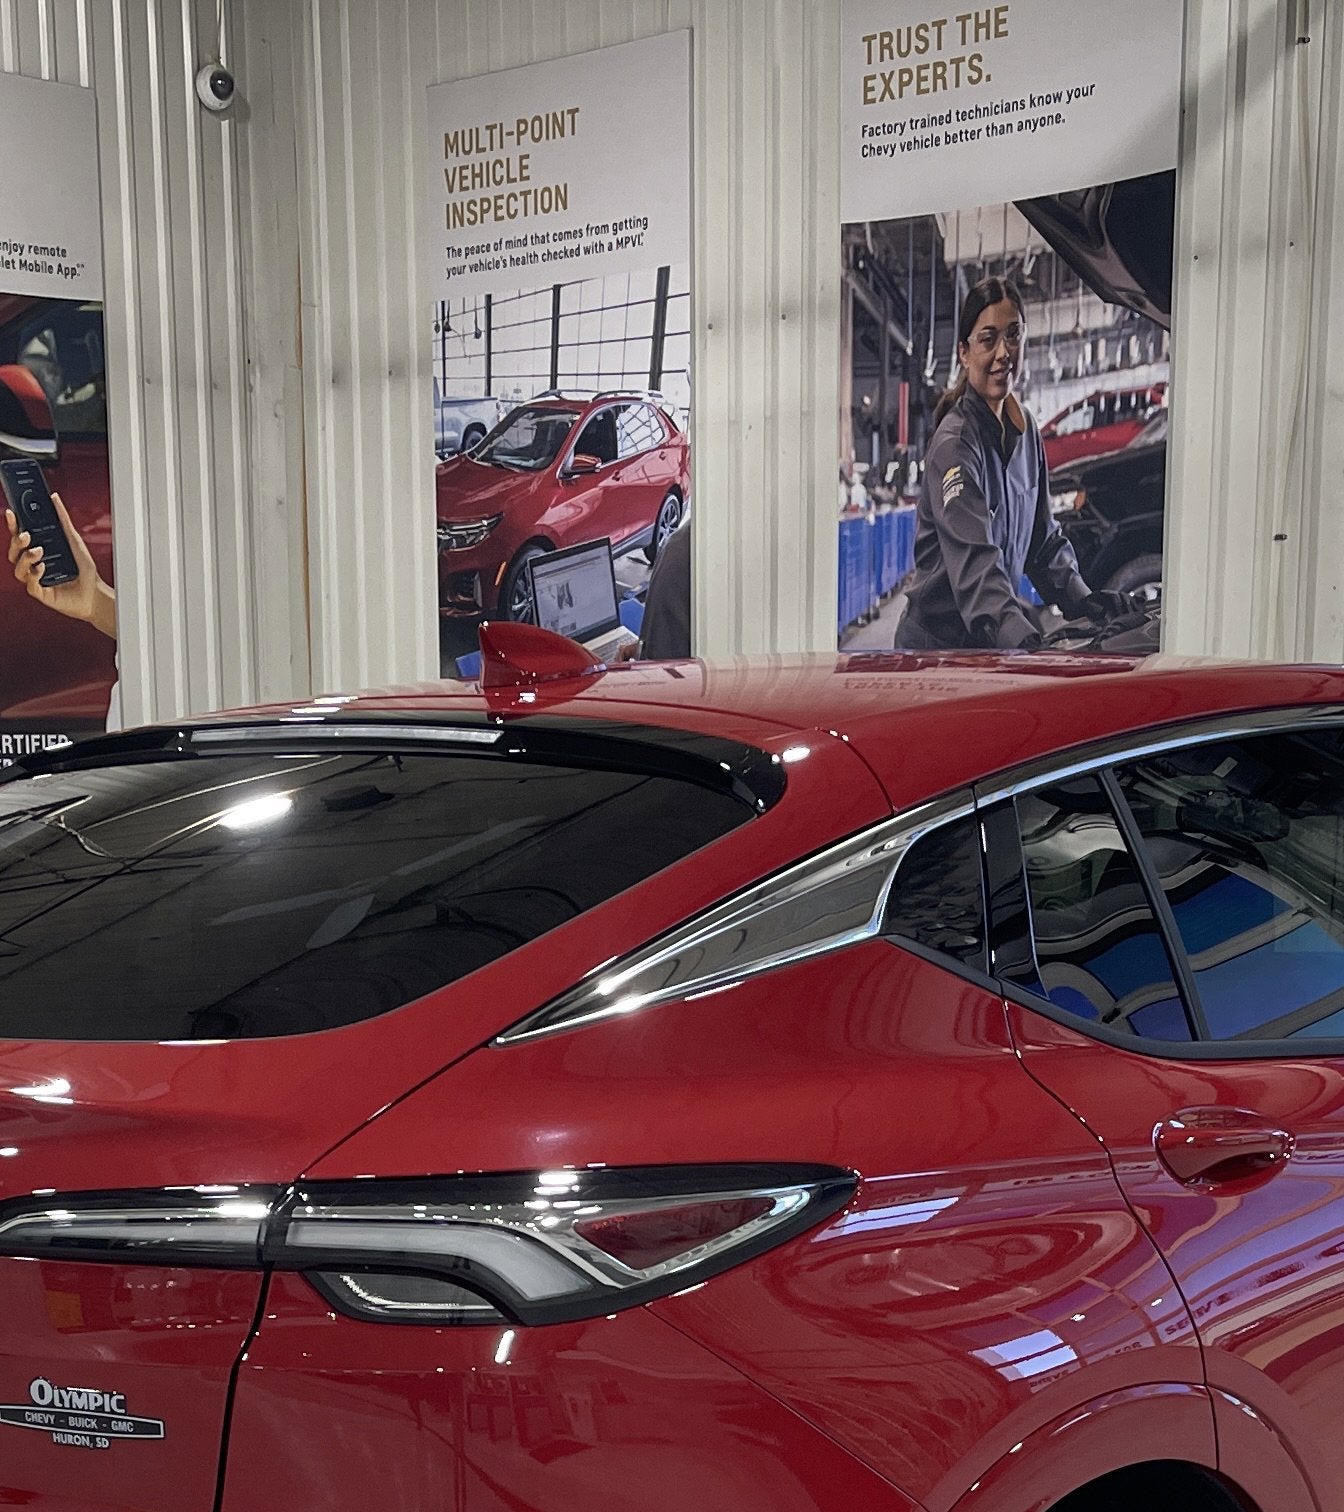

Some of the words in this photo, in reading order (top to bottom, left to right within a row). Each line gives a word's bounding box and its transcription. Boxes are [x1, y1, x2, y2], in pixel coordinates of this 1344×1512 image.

[861, 18, 947, 65] TRUST
[955, 5, 1009, 46] THE
[862, 53, 992, 105] EXPERTS.
[861, 118, 906, 138] Factory
[909, 110, 952, 131] trained
[955, 96, 1026, 123] technicians
[1029, 91, 1063, 109] know
[1066, 83, 1096, 104] your
[444, 107, 579, 159] MULTI-POINT
[861, 141, 897, 158] Chevy
[899, 133, 941, 152] vehicle
[944, 127, 982, 146] better
[985, 122, 1013, 138] than
[1017, 111, 1065, 134] anyone.
[444, 153, 530, 194] VEHICLE
[446, 182, 568, 230] INSPECTION
[28, 244, 67, 258] remote
[446, 246, 462, 259] The
[465, 242, 491, 258] peace
[493, 238, 503, 251] of
[505, 235, 528, 250] mind
[530, 232, 550, 246] that
[552, 229, 583, 243] comes
[586, 223, 609, 237] from
[612, 215, 649, 236] getting
[19, 259, 53, 274] Mobile
[446, 265, 466, 279] your
[468, 256, 507, 272] vehicle's
[509, 250, 539, 268] health
[541, 244, 581, 263] checked
[583, 241, 605, 256] with
[607, 242, 613, 252] a
[30, 1378, 125, 1413] OLYMPIC
[24, 1411, 55, 1425] CHEVY
[68, 1416, 97, 1429] BUICK
[111, 1421, 134, 1432] GMC
[53, 1433, 94, 1448] HURON,
[96, 1438, 109, 1448] SD
